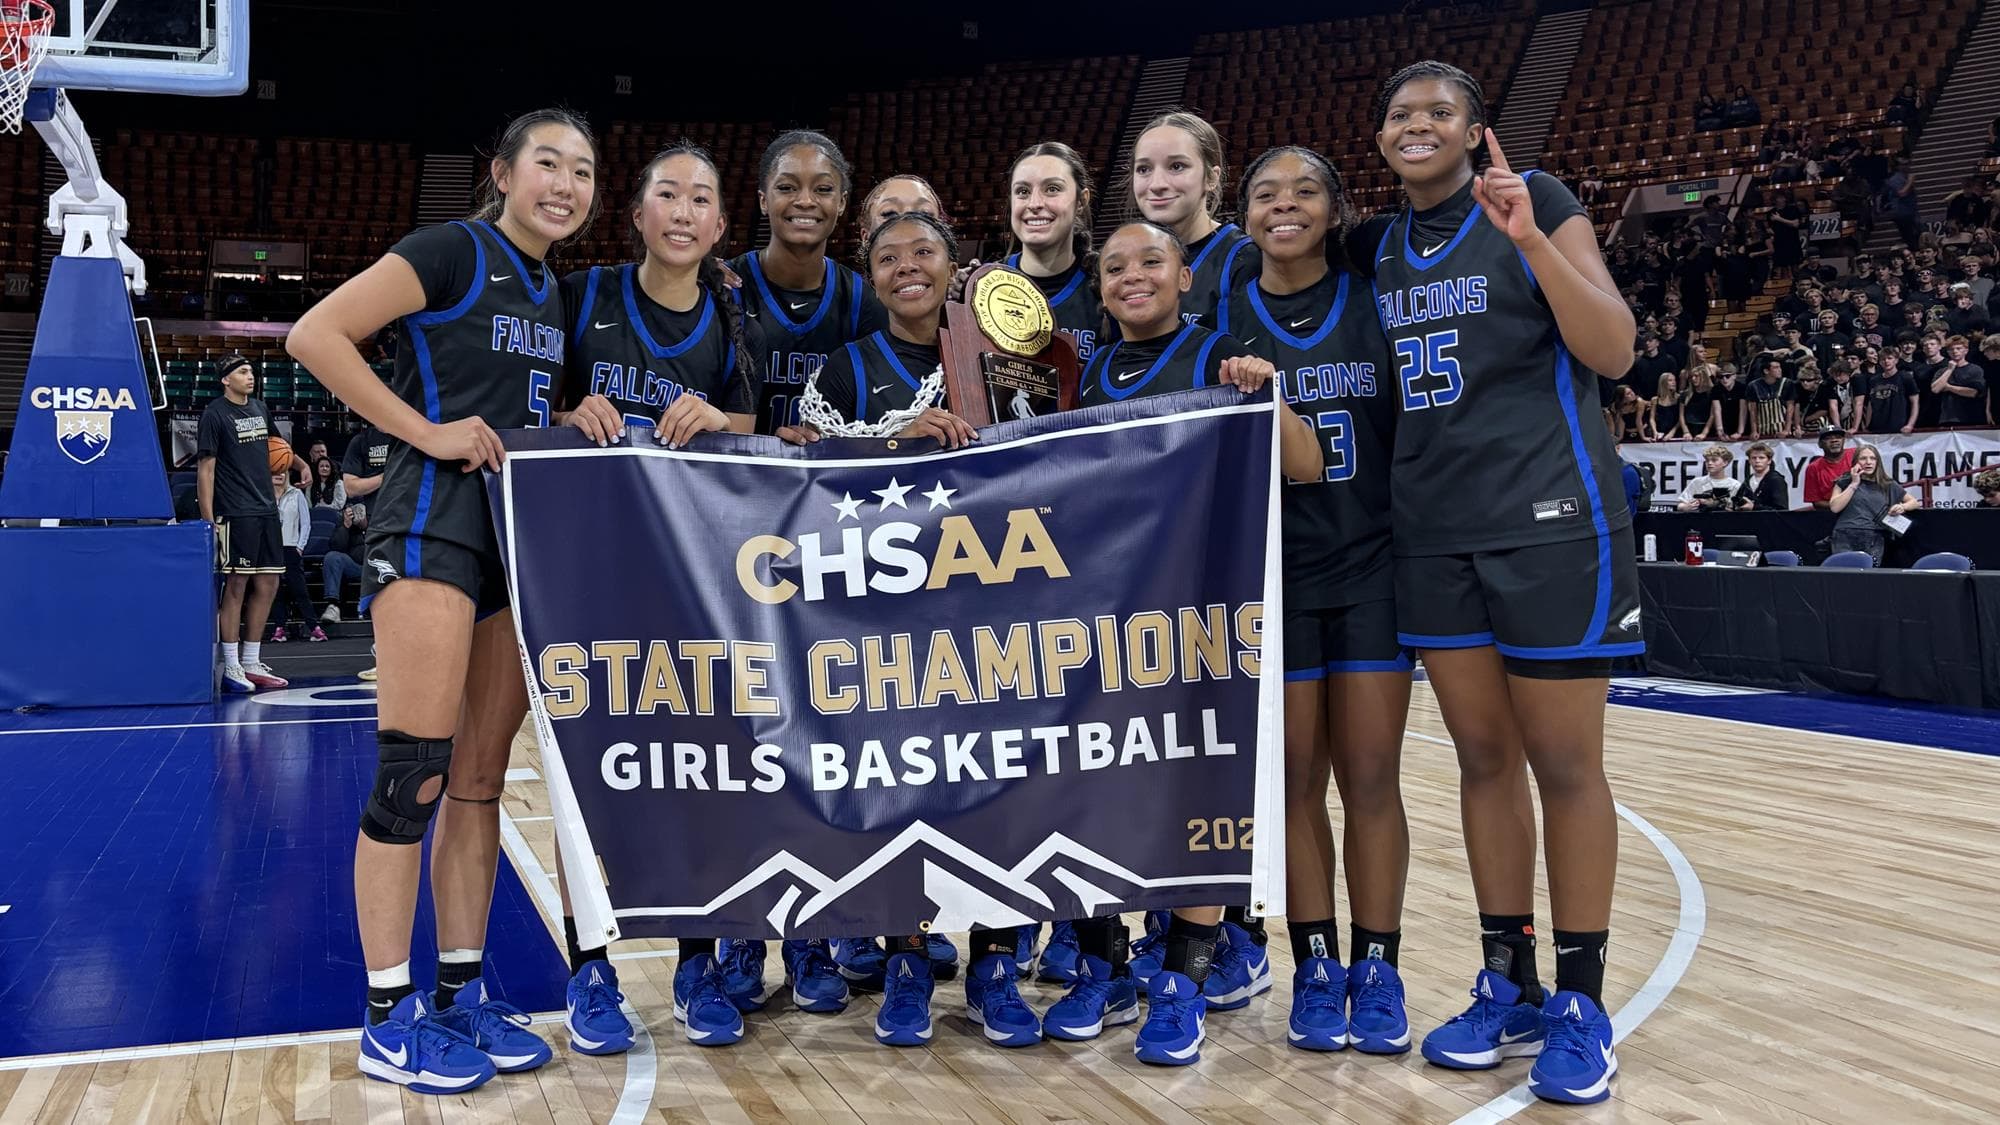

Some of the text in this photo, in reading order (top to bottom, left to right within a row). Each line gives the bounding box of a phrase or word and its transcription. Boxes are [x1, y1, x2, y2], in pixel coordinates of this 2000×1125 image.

[1813, 218, 1839, 235] 222
[590, 362, 708, 412] FALCO
[994, 365, 1048, 384] BASKETBALL
[1008, 361, 1033, 373] GIRLS
[1394, 329, 1464, 411] 25
[31, 386, 137, 410] CHSAA
[524, 369, 551, 429] 5
[1562, 503, 1575, 512] XL
[736, 508, 1071, 605] CHSAA
[539, 639, 780, 720] STATE
[808, 601, 1265, 715] CHAMPIONS
[600, 708, 1237, 793] GIRLS BASKETBALL
[1187, 817, 1254, 851] 202
